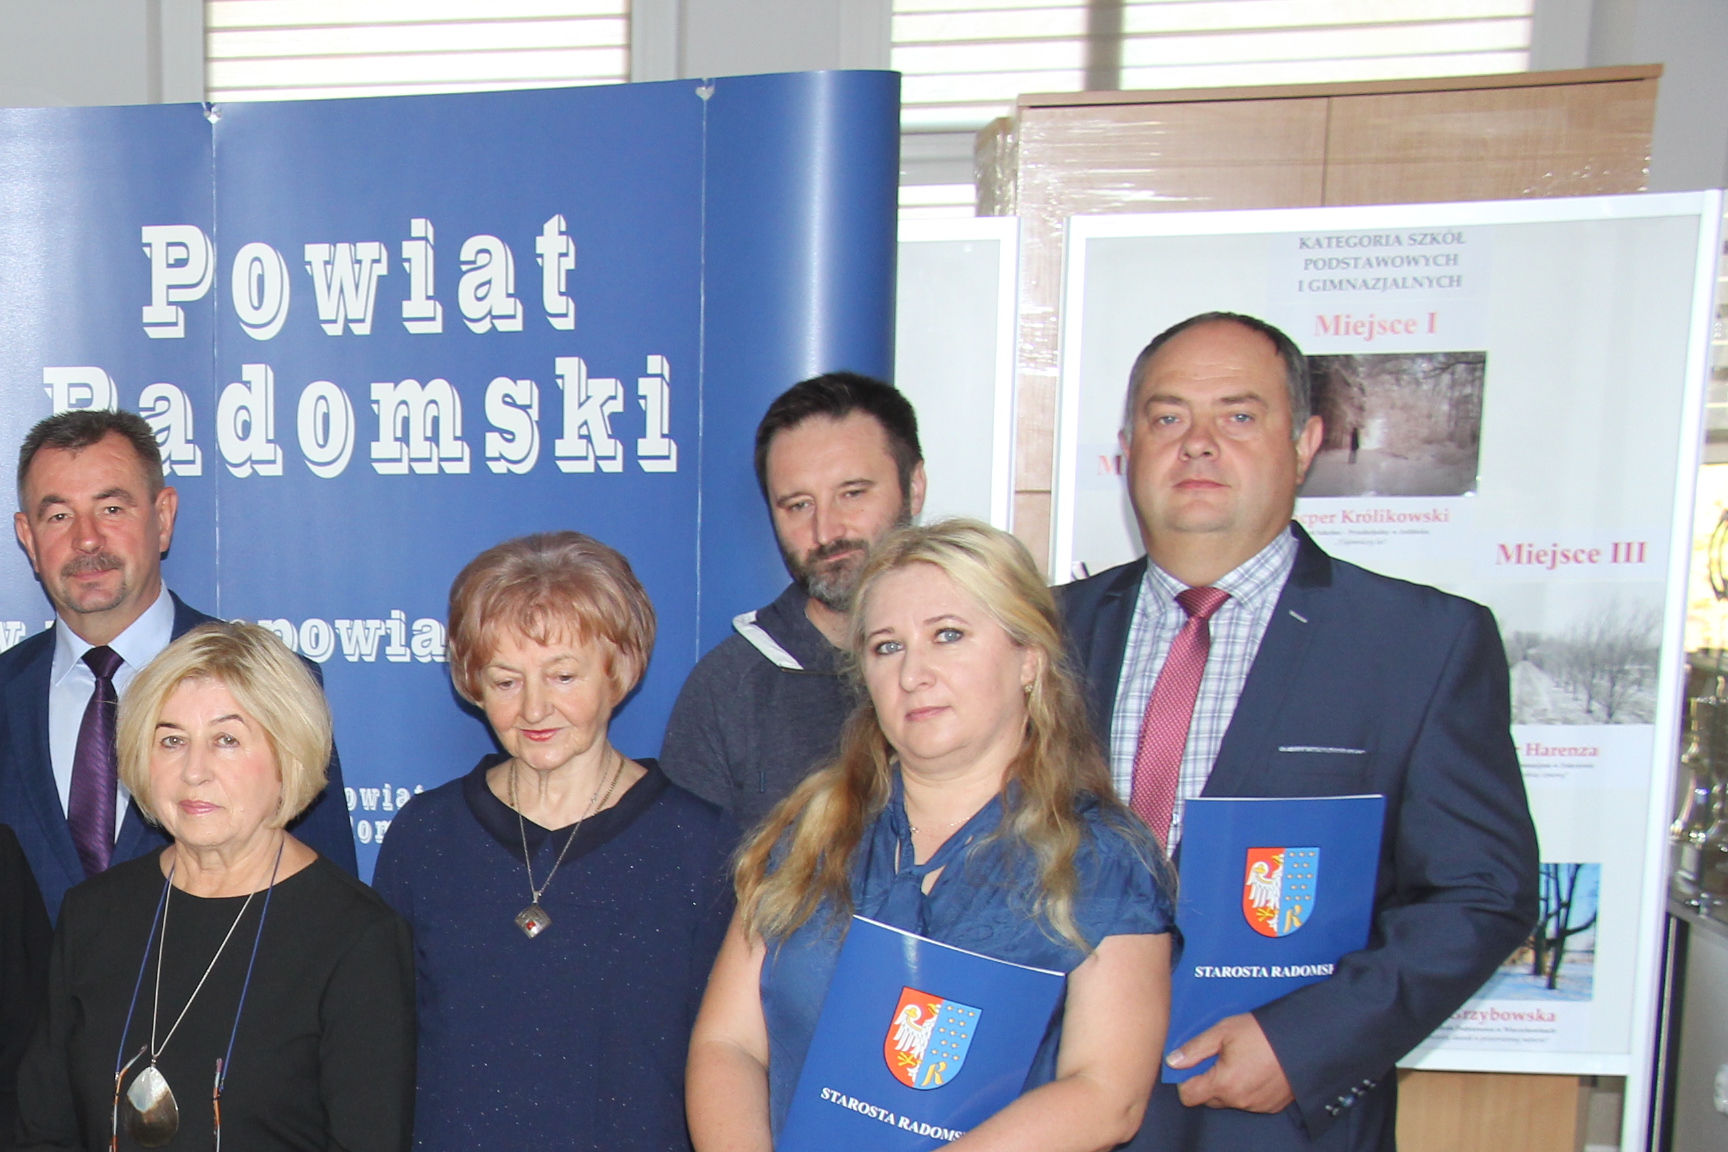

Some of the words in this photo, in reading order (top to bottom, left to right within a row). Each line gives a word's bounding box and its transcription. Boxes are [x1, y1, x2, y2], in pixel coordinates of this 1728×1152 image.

[1298, 234, 1403, 250] KATEGORIA
[1407, 229, 1466, 247] SZKÓŁ
[1303, 253, 1460, 271] PODSTAWOWYCH
[141, 214, 576, 341] Powiat
[1297, 280, 1304, 292] I
[1308, 275, 1464, 292] GIMNAZJALNYCH
[1314, 313, 1418, 342] Miejsce
[1426, 312, 1438, 334] I
[1340, 508, 1450, 525] Królikowski
[1495, 543, 1601, 570] Miejsce
[1610, 542, 1647, 563] III
[1525, 743, 1598, 757] Harenza
[1194, 965, 1269, 978] STAROSTA
[820, 1087, 896, 1125] STAROSTA
[897, 1115, 967, 1142] RADOMS
